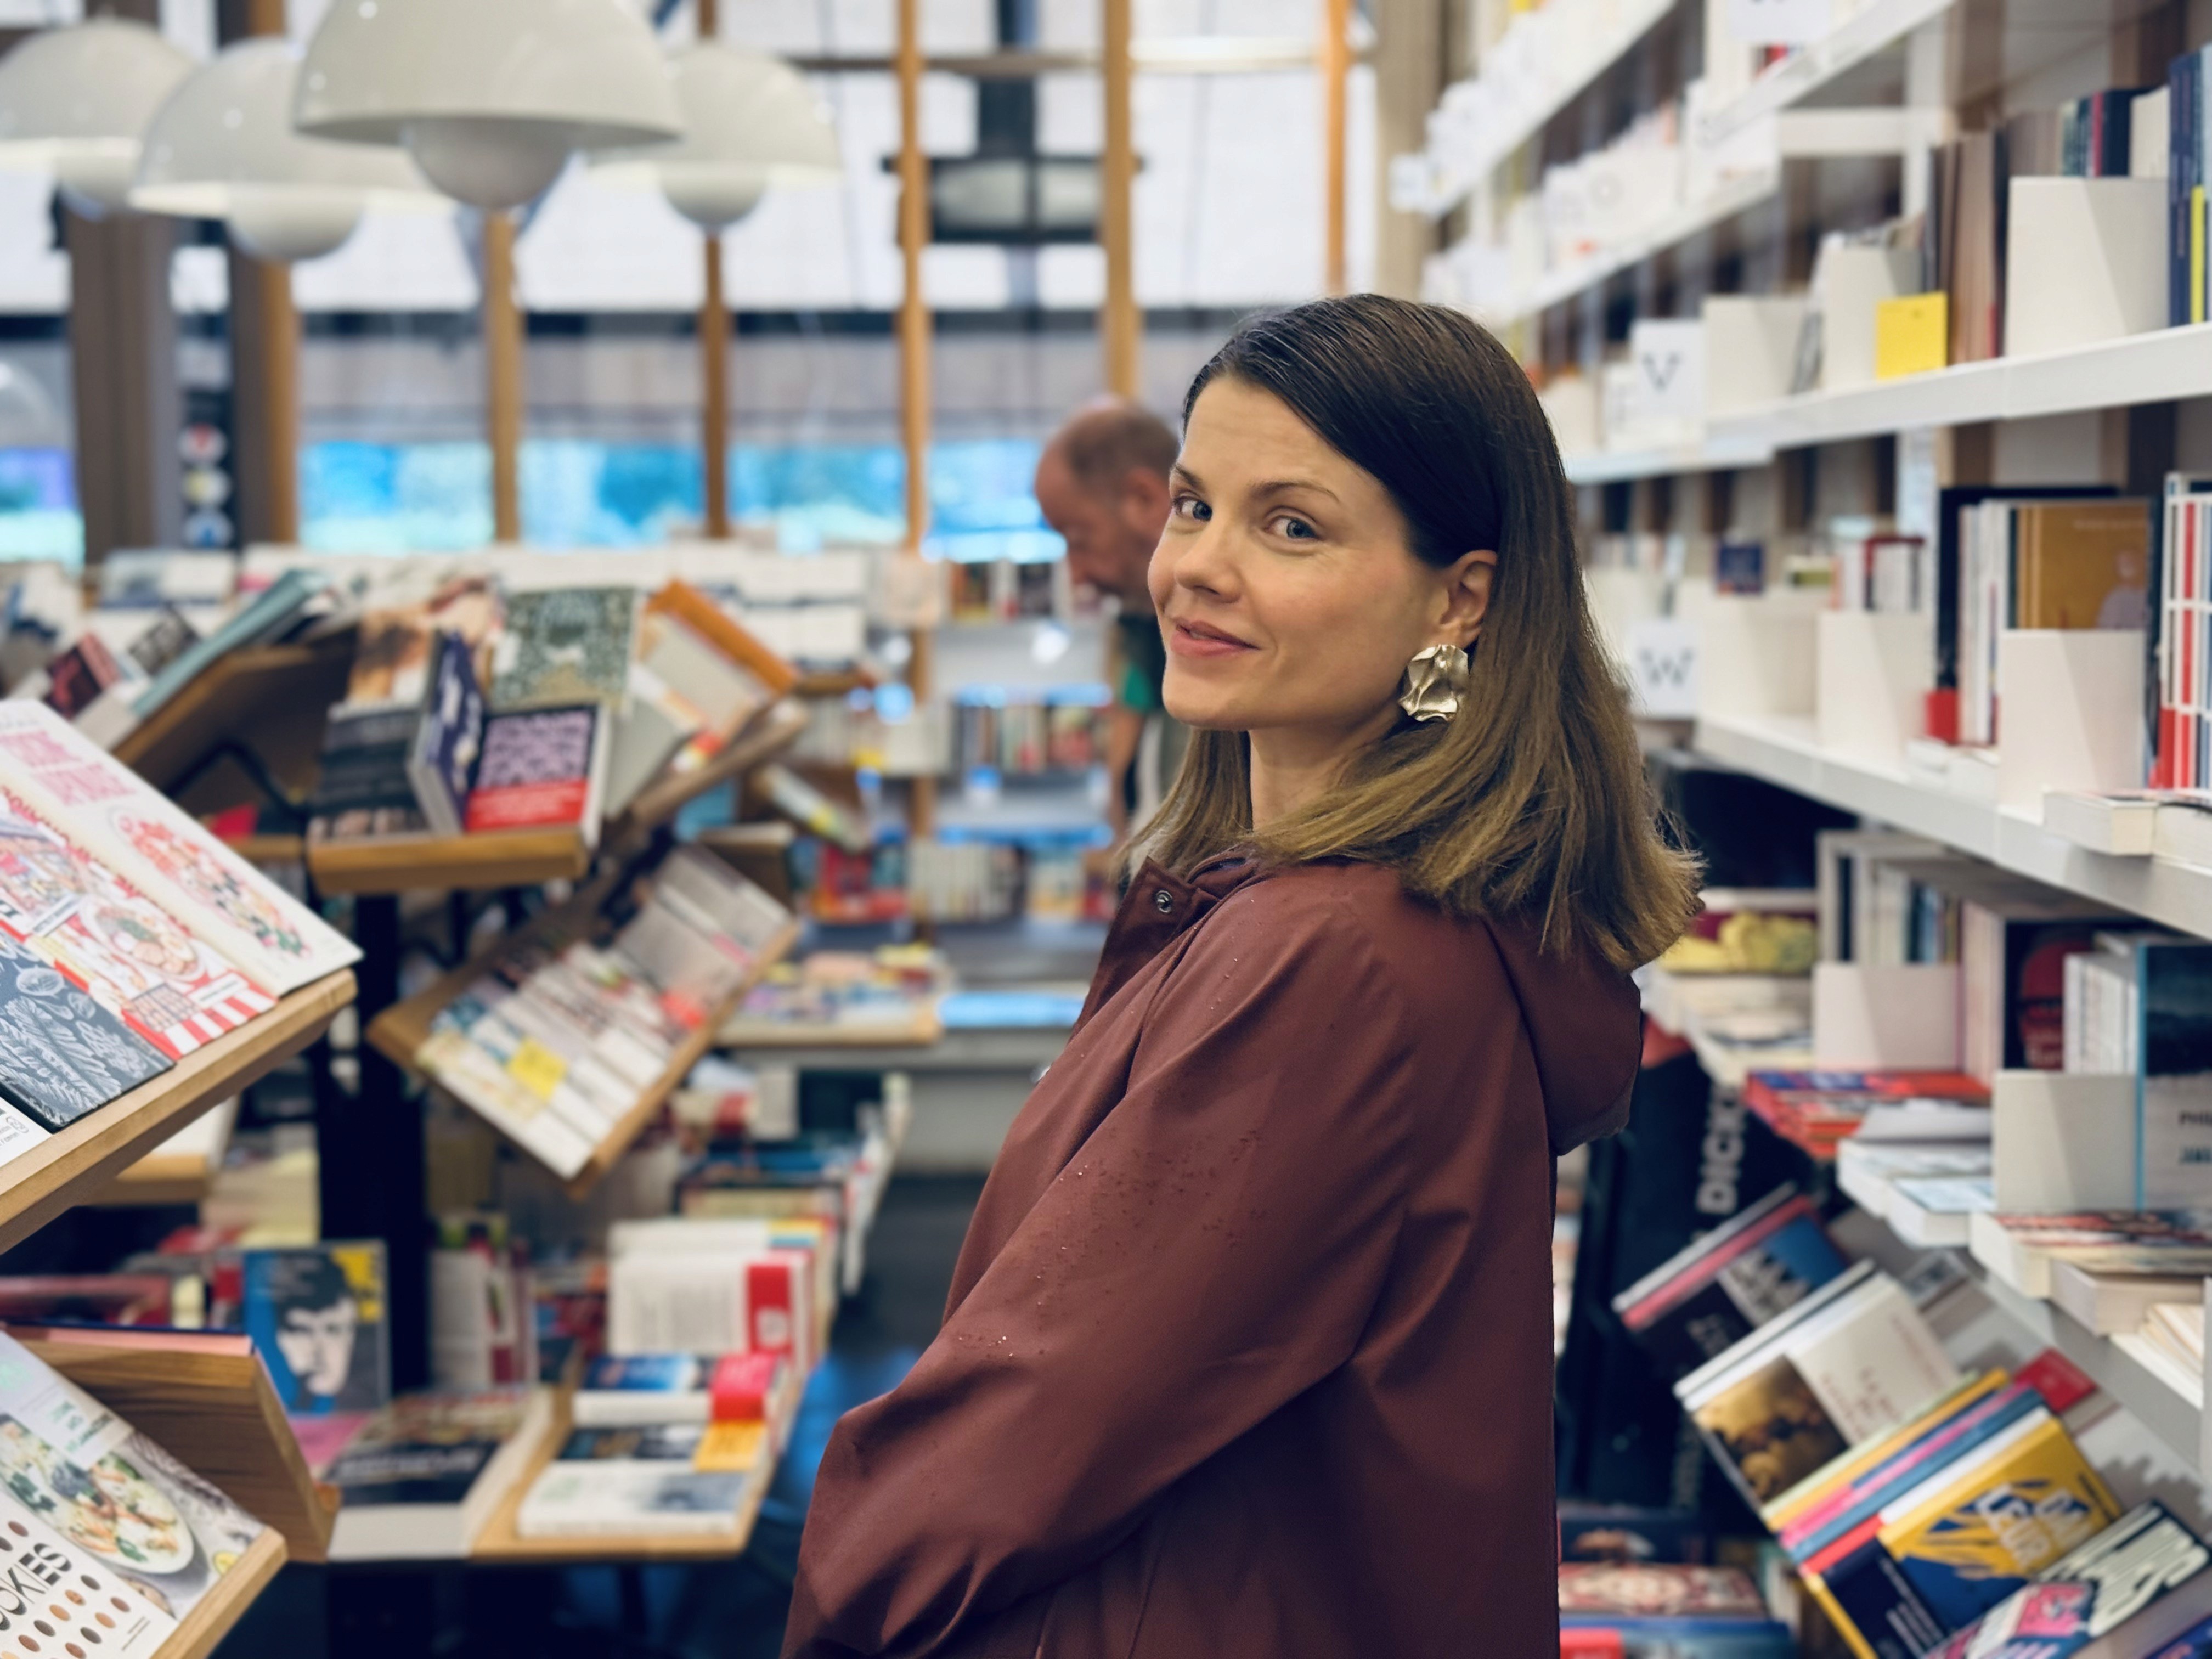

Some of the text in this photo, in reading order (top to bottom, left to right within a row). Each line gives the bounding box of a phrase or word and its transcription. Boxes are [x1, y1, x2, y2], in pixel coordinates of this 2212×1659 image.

[1641, 351, 1681, 393] V
[1638, 647, 1696, 689] W
[0, 1543, 72, 1631] OKIES
